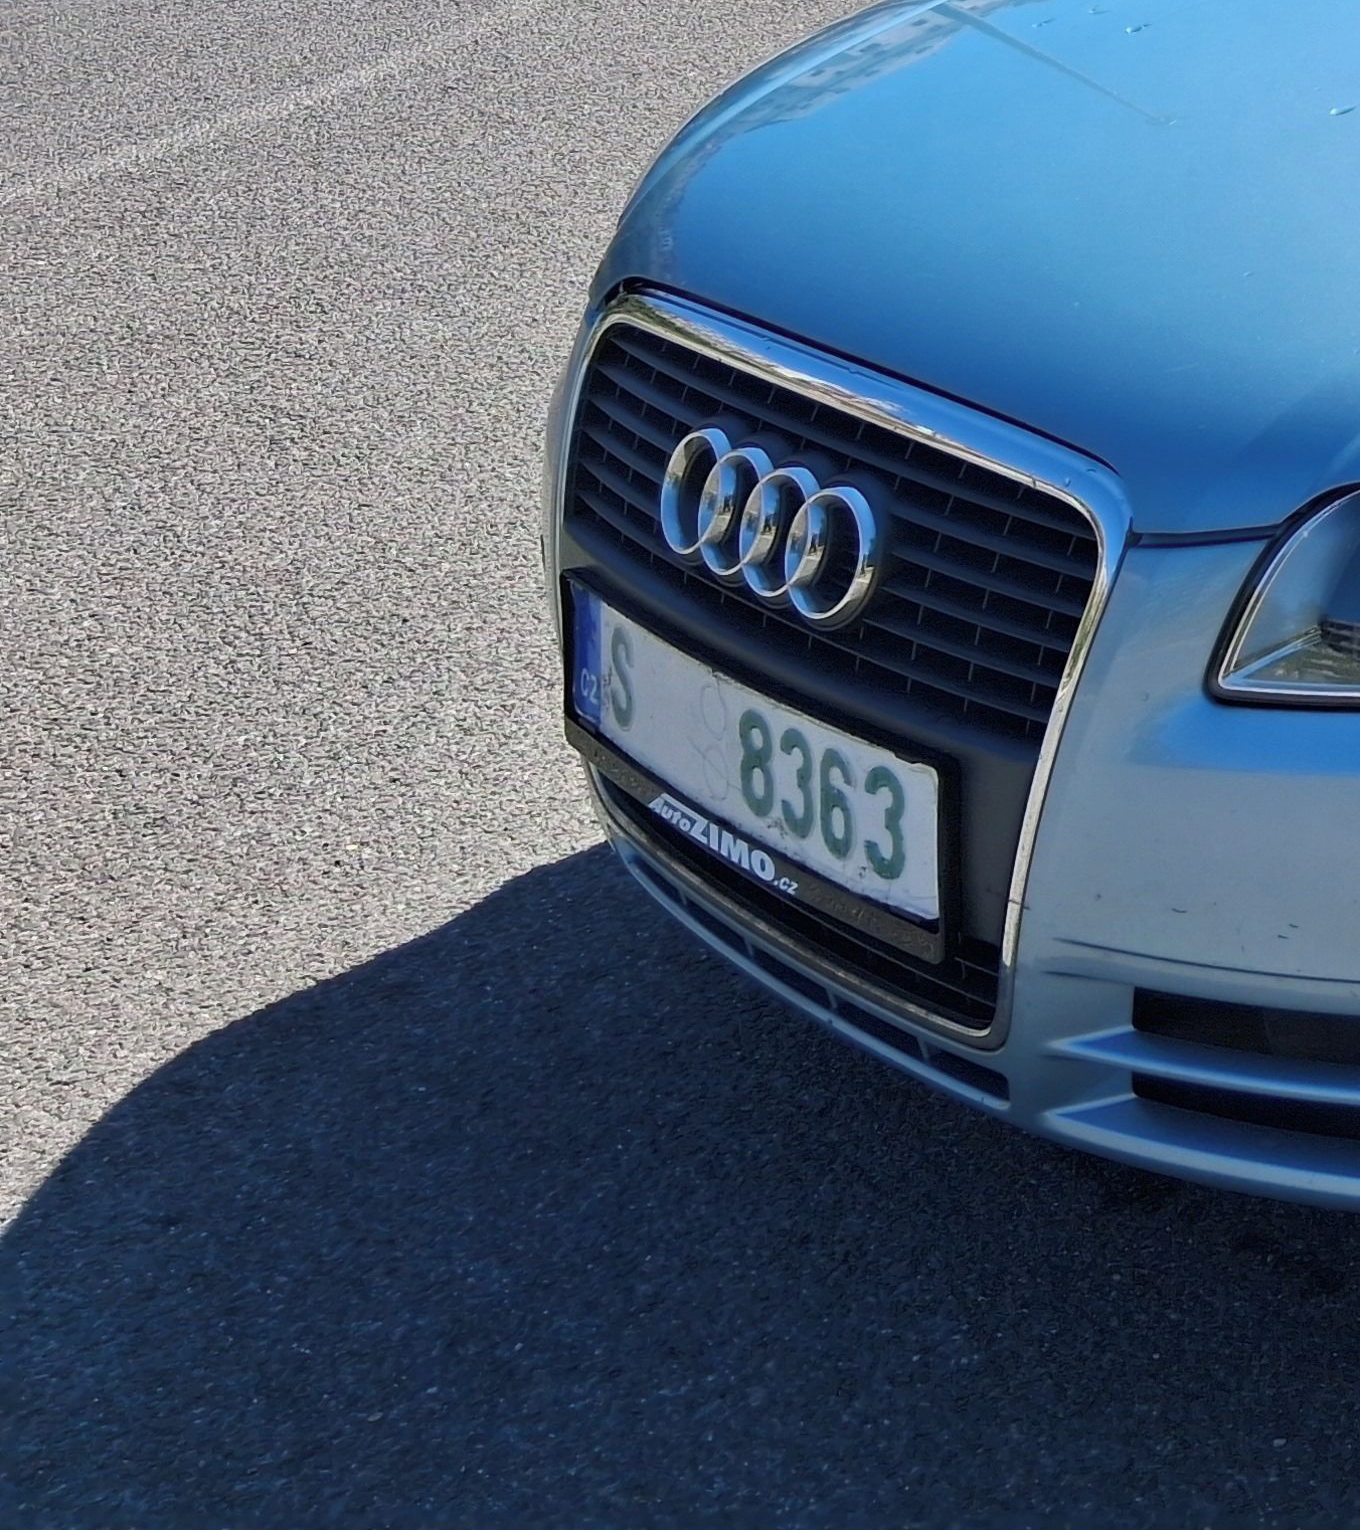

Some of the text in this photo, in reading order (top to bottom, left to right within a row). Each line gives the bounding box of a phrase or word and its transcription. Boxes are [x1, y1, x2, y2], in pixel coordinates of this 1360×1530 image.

[580, 667, 599, 705] CZ
[610, 627, 905, 881] S 8363
